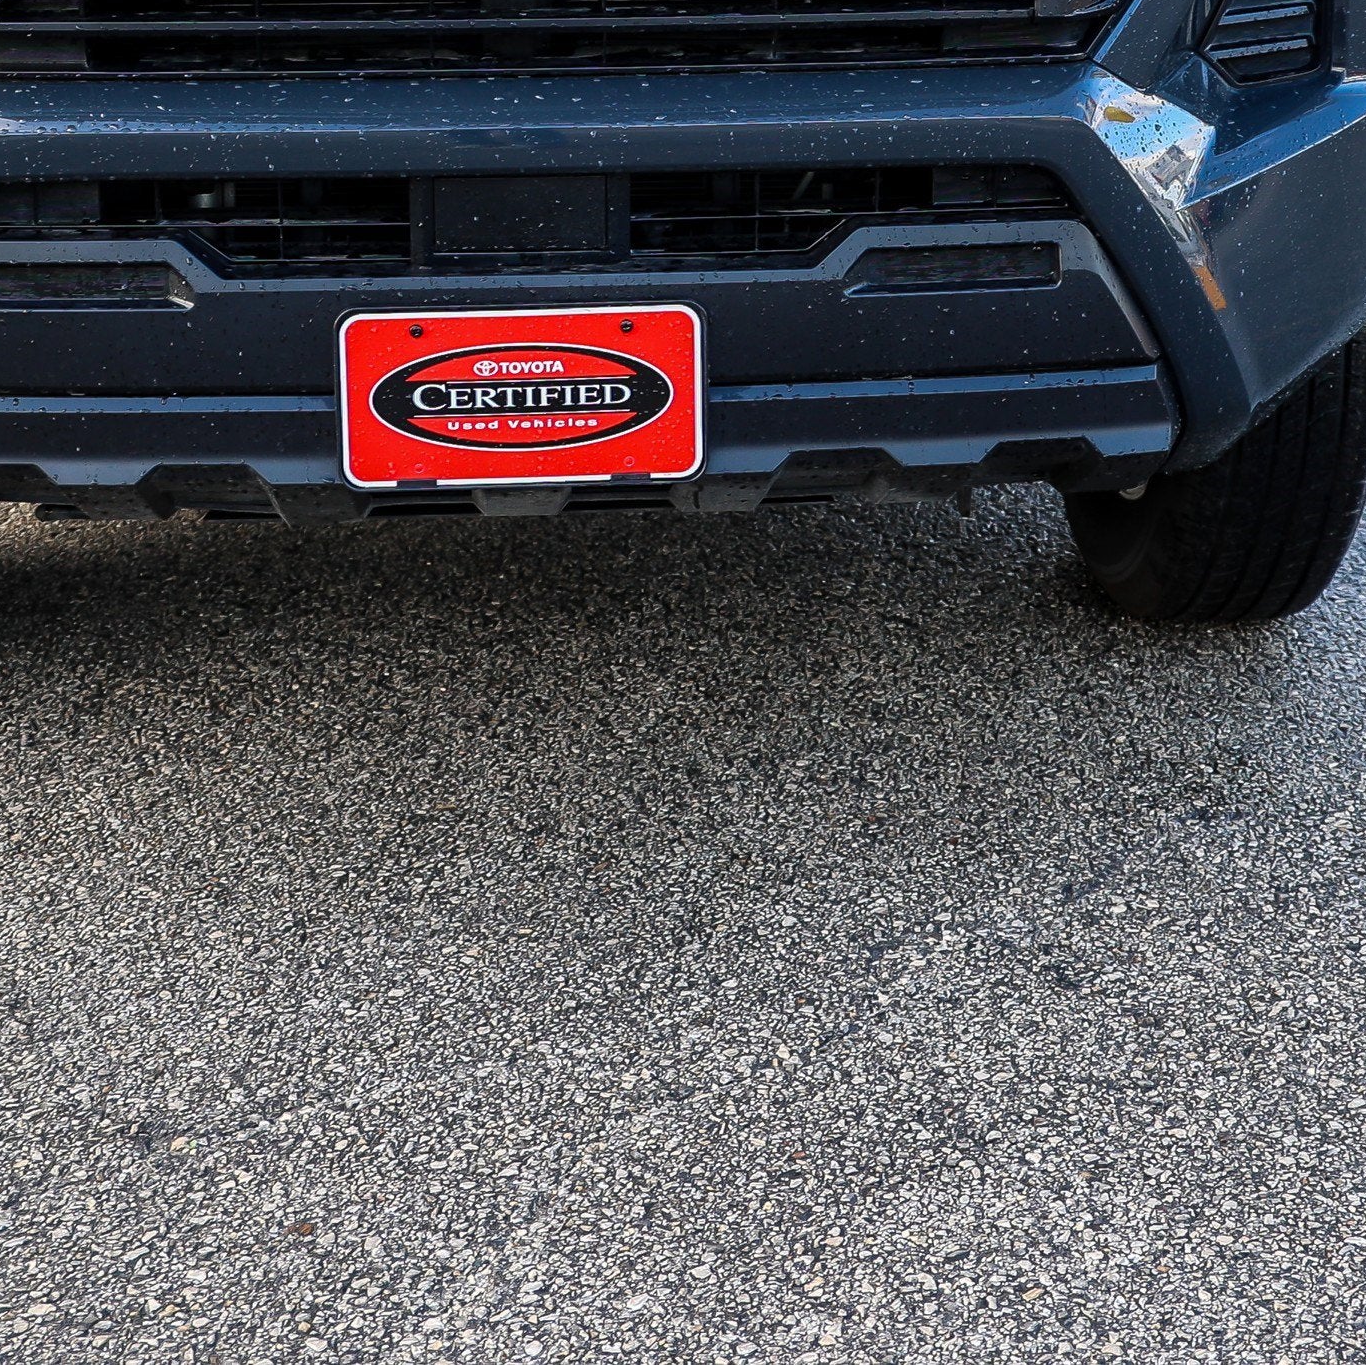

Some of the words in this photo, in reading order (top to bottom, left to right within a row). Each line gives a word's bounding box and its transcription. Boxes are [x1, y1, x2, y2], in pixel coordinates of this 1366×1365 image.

[499, 361, 564, 375] TOYOTA
[413, 384, 631, 411] CERTIFIED
[447, 420, 499, 431] Used
[508, 418, 598, 430] Vehicles
